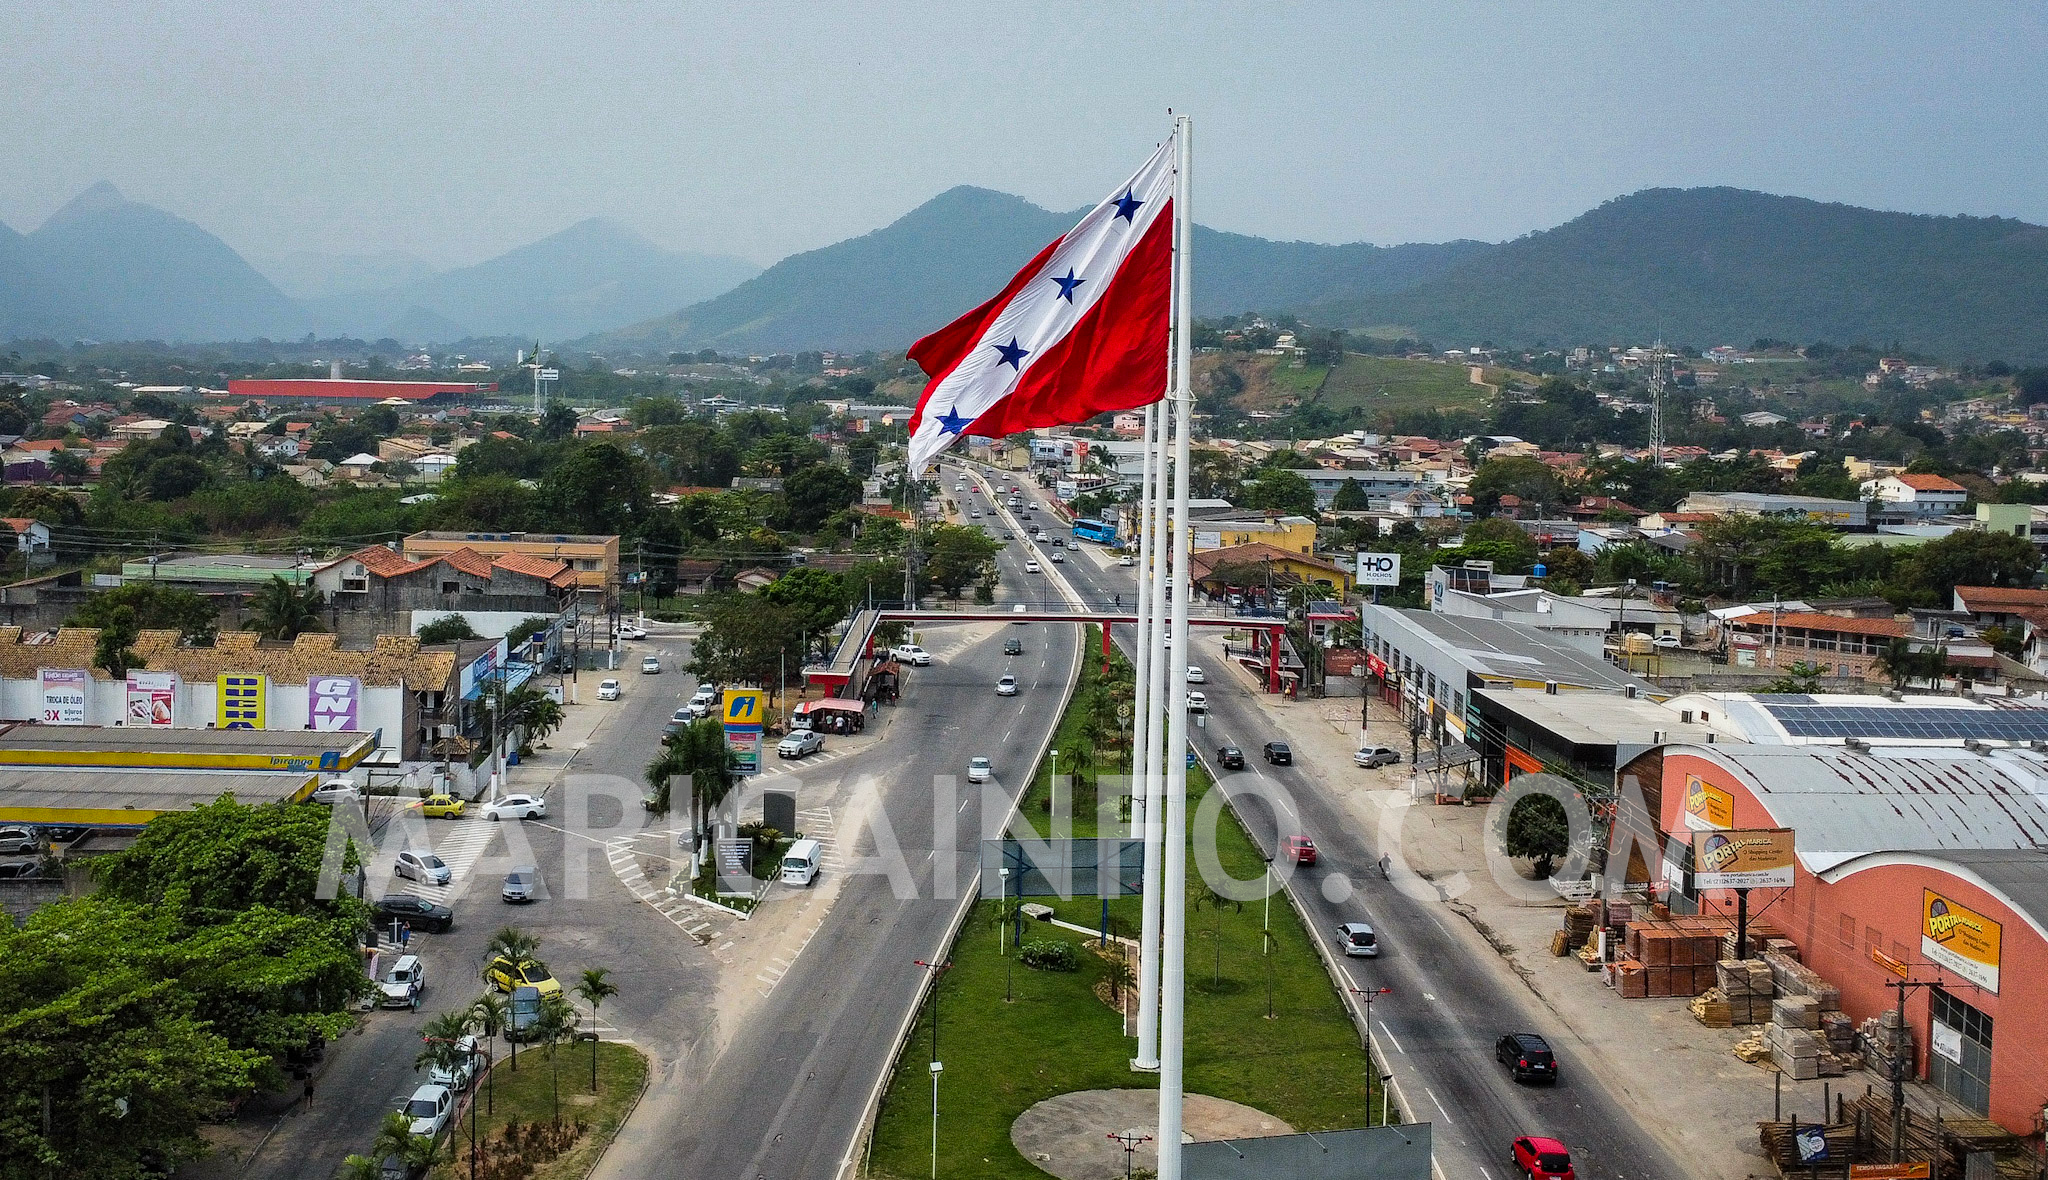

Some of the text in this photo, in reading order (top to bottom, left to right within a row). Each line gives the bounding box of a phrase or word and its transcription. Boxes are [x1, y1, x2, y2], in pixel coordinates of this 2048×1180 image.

[46, 695, 62, 704] TROCA
[63, 696, 70, 704] DE
[314, 679, 352, 730] GNV
[44, 710, 60, 721] 3X
[270, 757, 313, 767] Ipiranga
[1702, 840, 1746, 870] PORTAL
[1928, 915, 1962, 939] PORTAL
